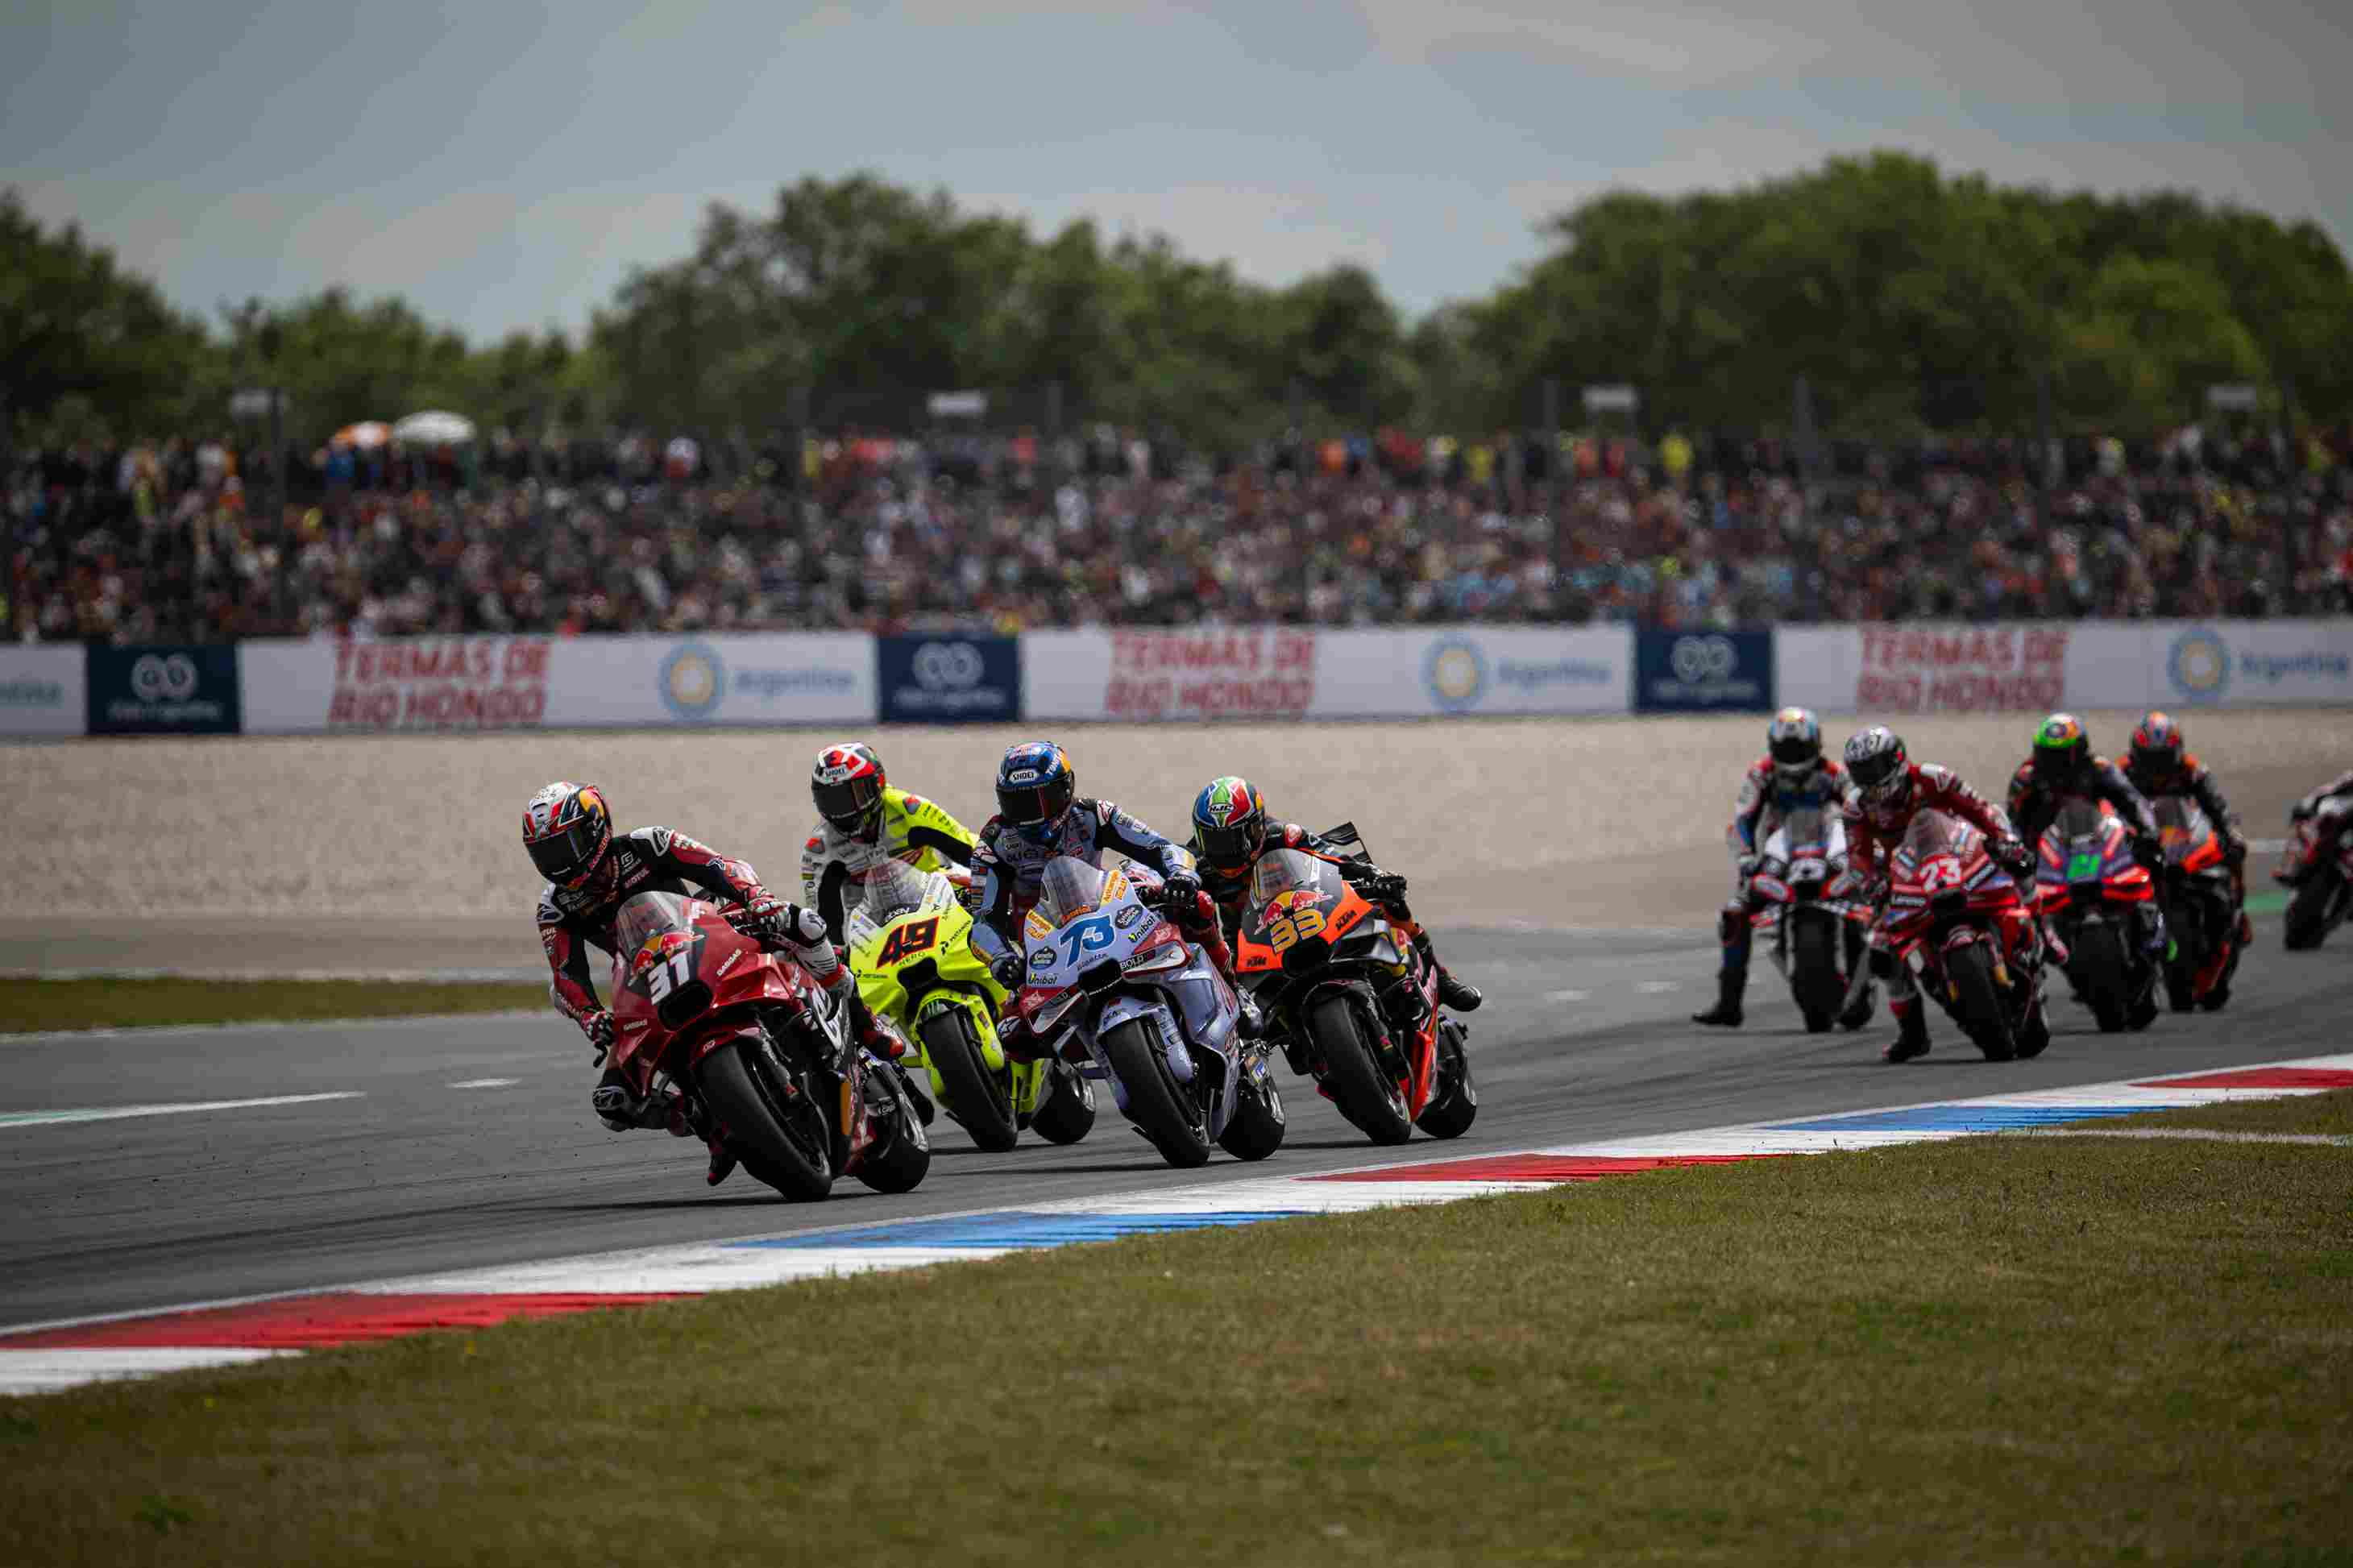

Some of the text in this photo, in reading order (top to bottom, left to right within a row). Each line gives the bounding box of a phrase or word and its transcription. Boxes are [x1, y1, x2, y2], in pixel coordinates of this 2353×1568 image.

[334, 642, 489, 681] TERMAS
[1863, 631, 2011, 670] TERMAS
[329, 688, 543, 723] RIO HONDO
[1934, 675, 2064, 711] HONDO
[1012, 772, 1035, 782] SHOEI
[1920, 857, 1962, 891] 23
[1269, 907, 1328, 955] 33
[1335, 910, 1357, 931] KTM
[877, 916, 940, 969] 49
[1058, 915, 1116, 971] 73
[647, 950, 691, 1006] 31
